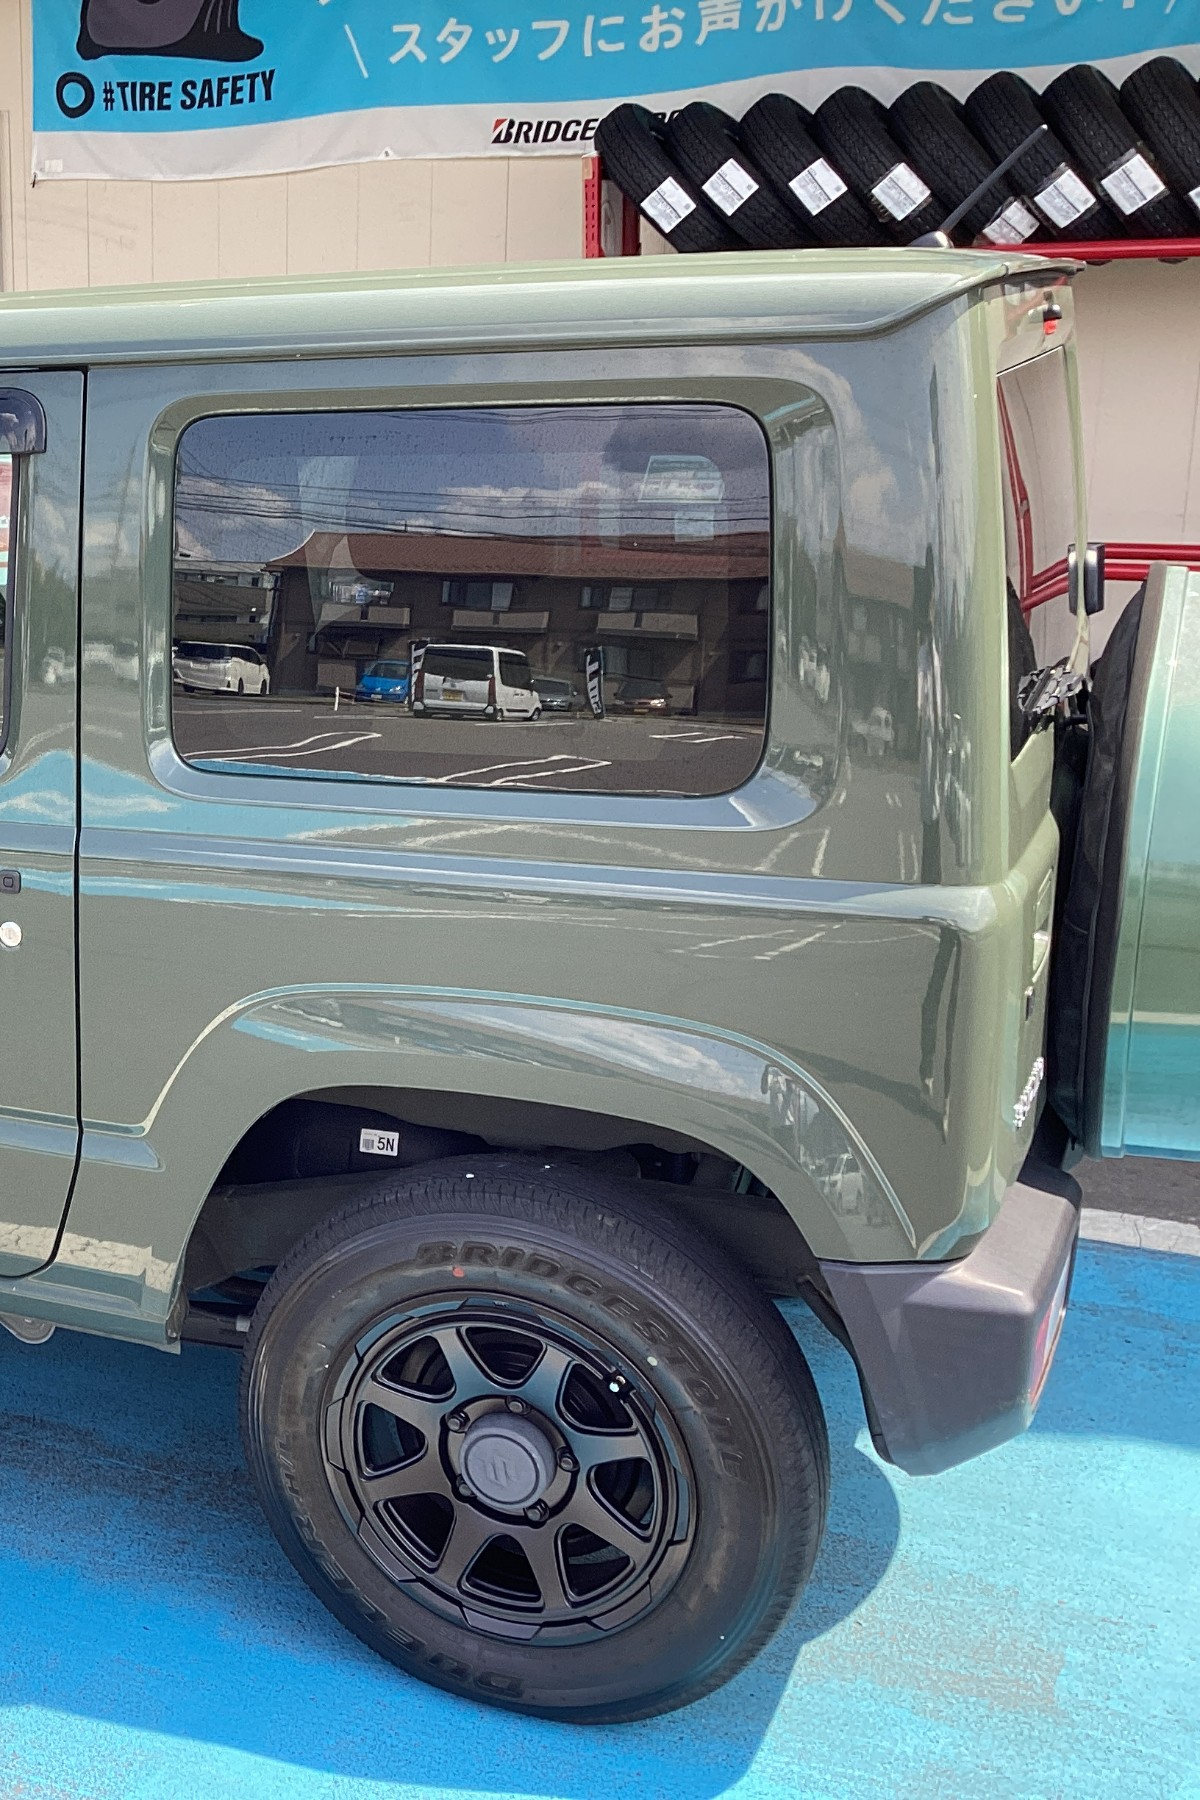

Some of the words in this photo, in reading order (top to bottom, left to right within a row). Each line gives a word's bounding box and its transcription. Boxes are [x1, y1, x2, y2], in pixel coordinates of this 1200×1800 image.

[103, 81, 172, 112] #TIRE
[181, 69, 276, 110] SAFETY
[492, 117, 600, 144] BRIDGE
[377, 1136, 396, 1152] 5N
[415, 1240, 751, 1478] BRIDGESTONE
